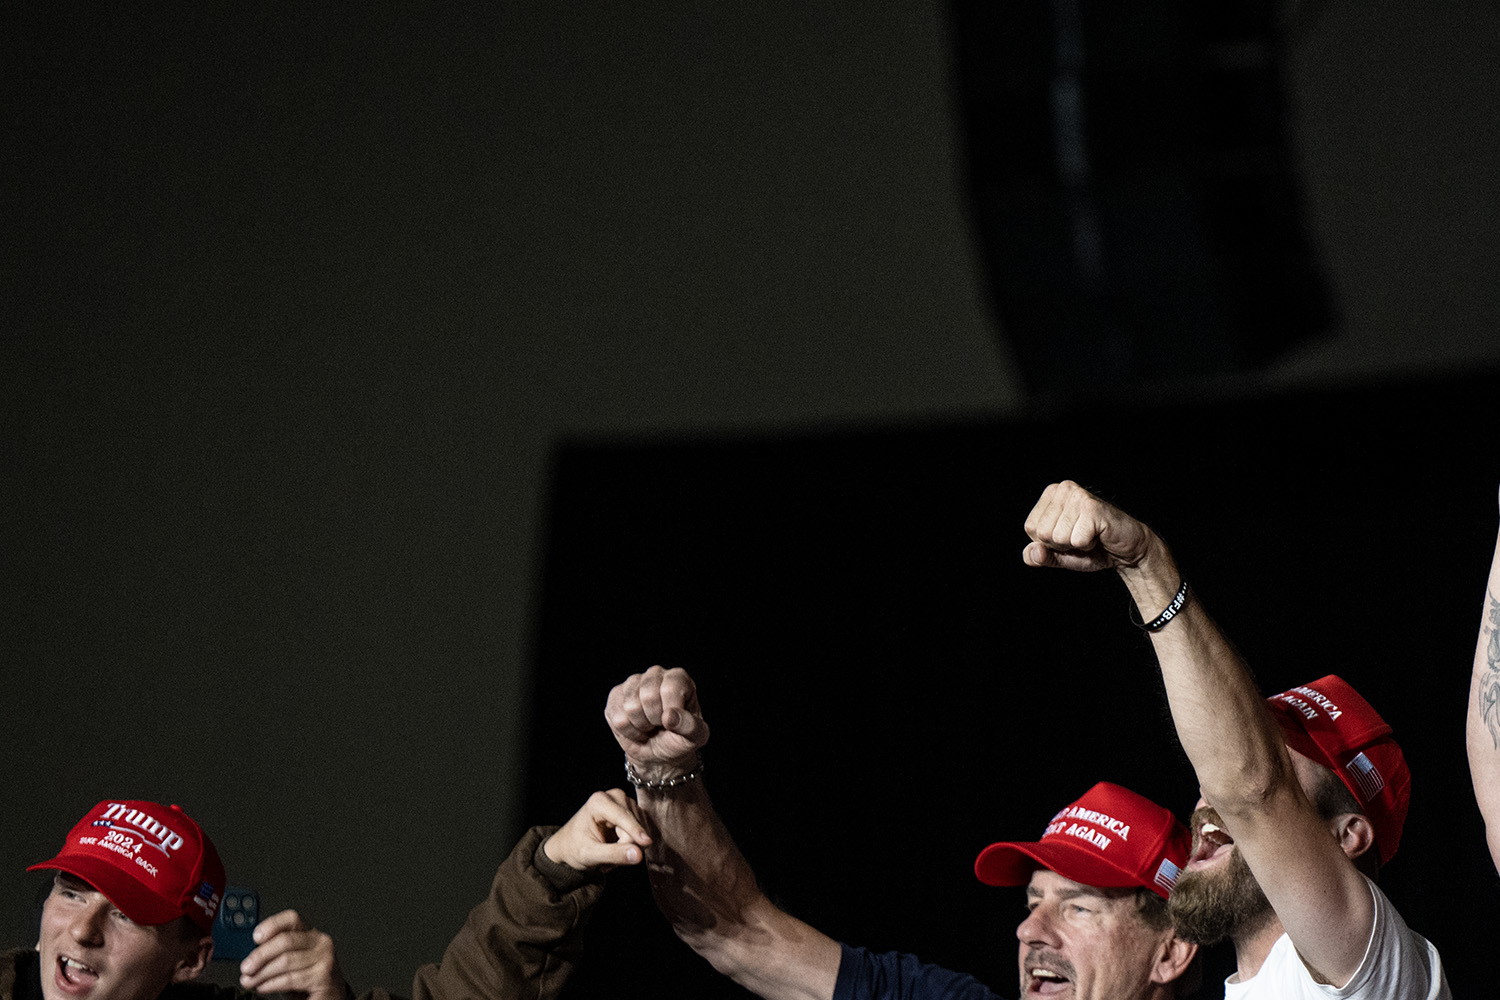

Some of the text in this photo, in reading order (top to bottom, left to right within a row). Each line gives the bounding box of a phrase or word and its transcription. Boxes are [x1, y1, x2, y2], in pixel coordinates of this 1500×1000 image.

[1162, 592, 1185, 620] #FJB
[100, 802, 184, 851] Trump
[1065, 822, 1112, 852] AGAIN
[1066, 805, 1131, 842] AMERICA
[97, 839, 134, 860] AMERICA
[135, 856, 159, 878] BACK
[104, 830, 143, 854] 2024
